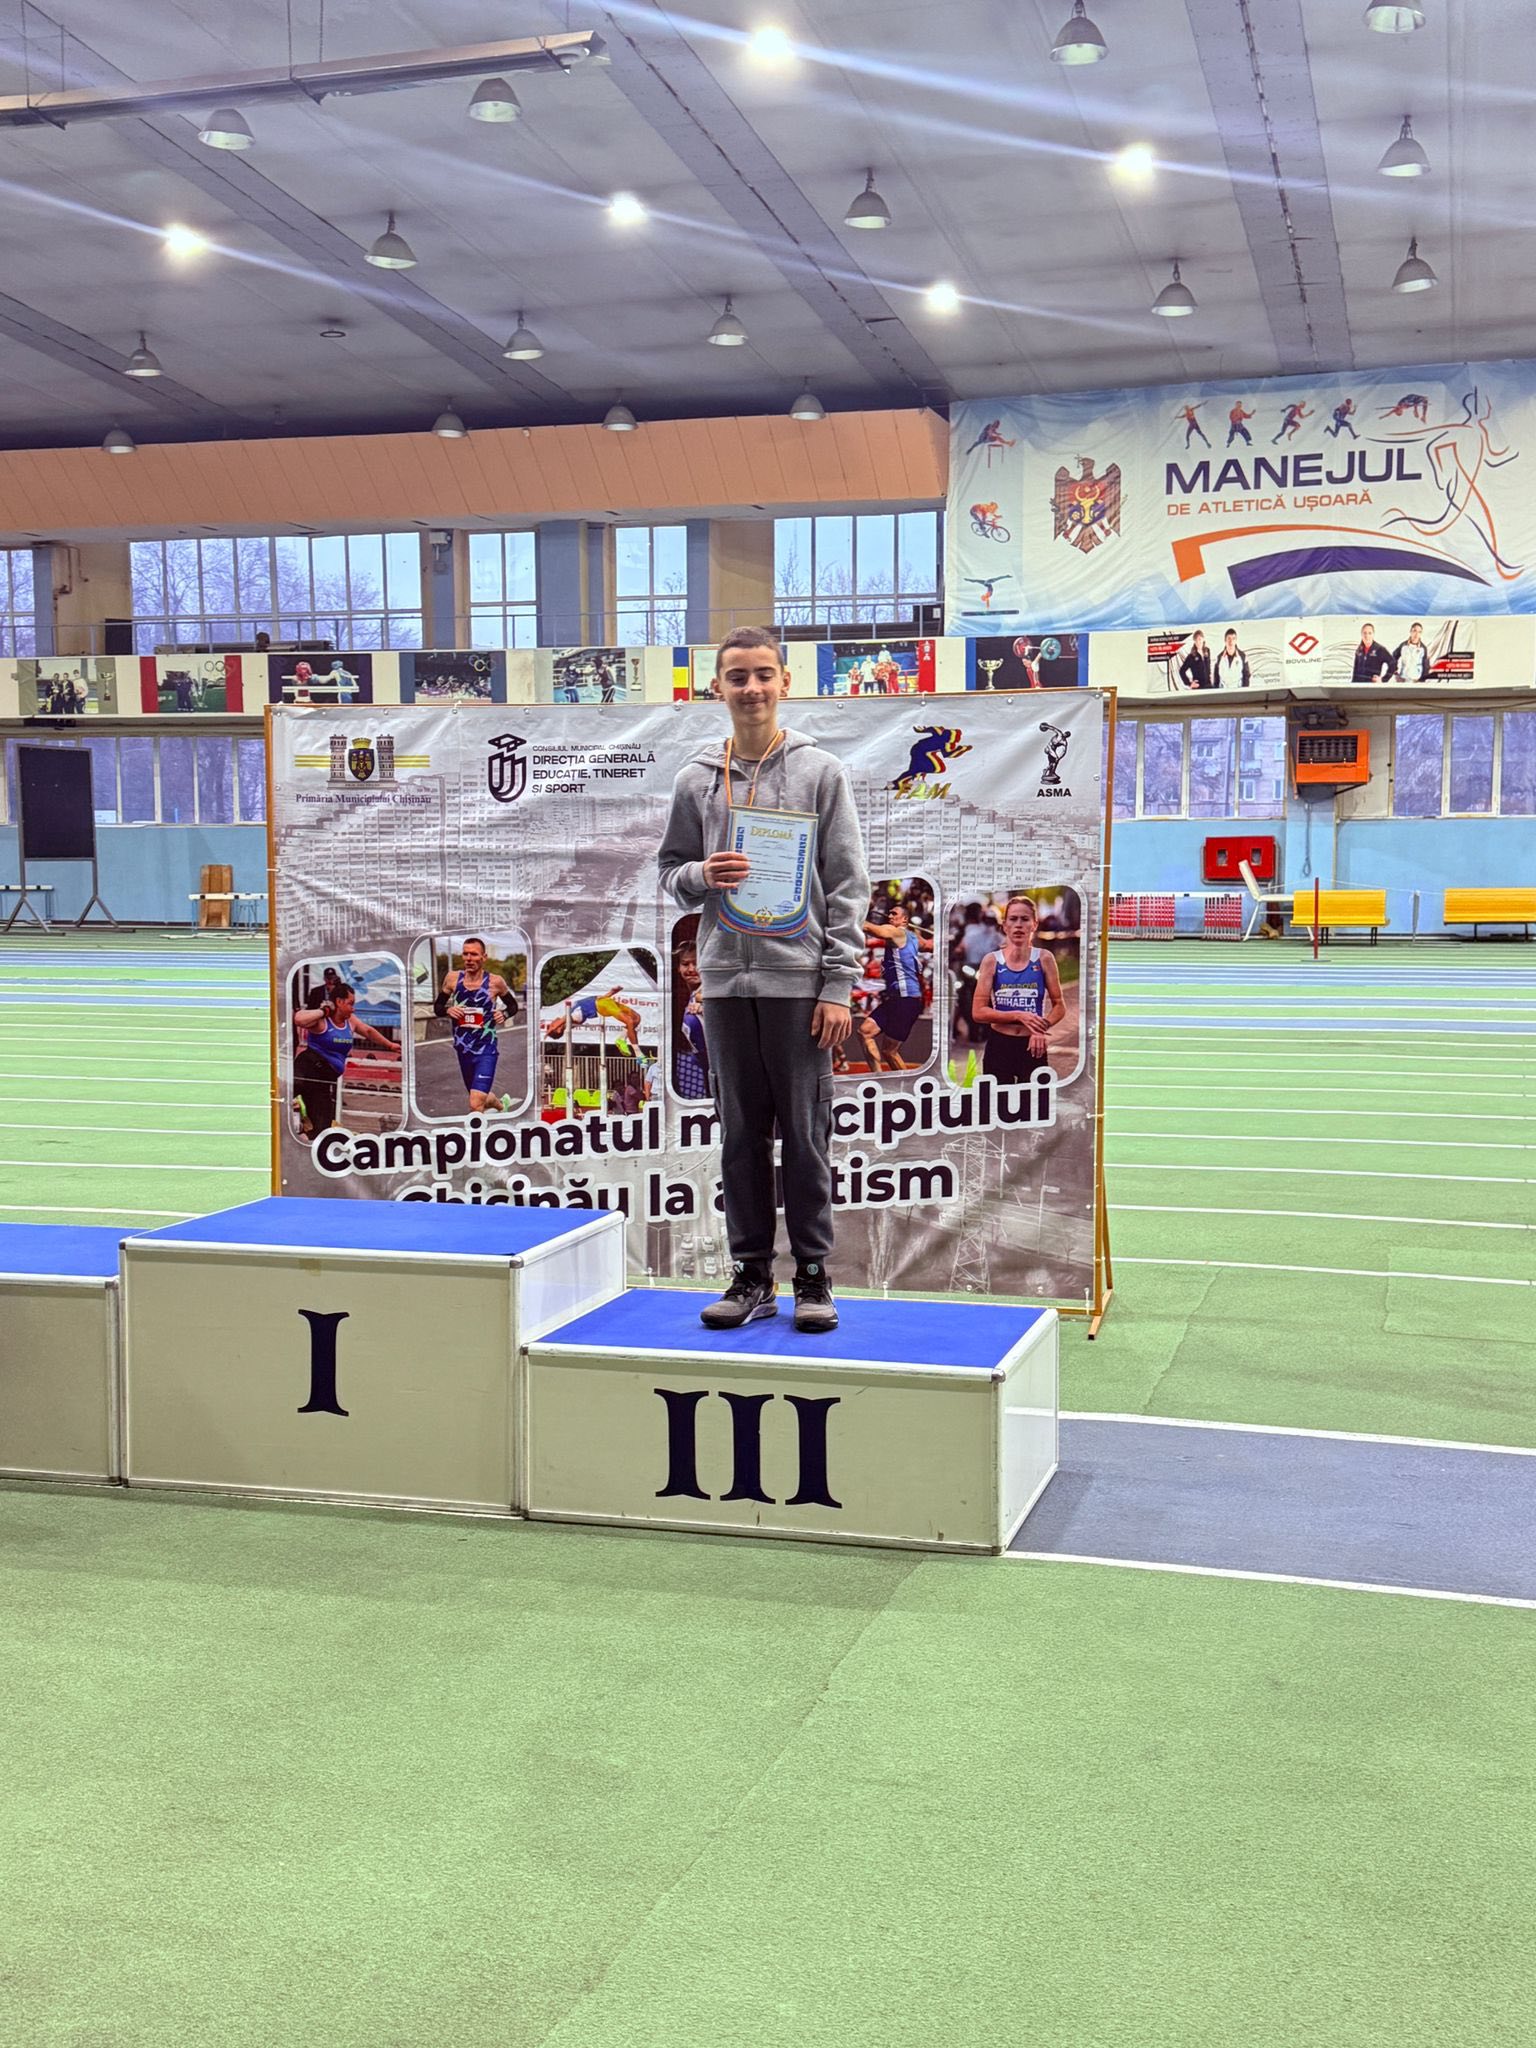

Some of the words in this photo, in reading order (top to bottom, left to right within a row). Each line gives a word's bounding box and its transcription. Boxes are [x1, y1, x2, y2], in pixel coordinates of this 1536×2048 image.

[1166, 448, 1422, 495] MANEJUL
[1167, 503, 1190, 516] DE
[1198, 495, 1286, 514] ATLETICĂ
[1294, 489, 1373, 512] UȘOARĂ
[1285, 656, 1322, 665] BOVILINE
[533, 754, 586, 767] DIRECȚIA
[588, 750, 656, 764] GENERALĂ
[593, 768, 646, 779] TINERET
[544, 783, 586, 794] SPORT
[1036, 788, 1072, 798] ASMA
[296, 793, 333, 804] Primăria
[997, 997, 1037, 1008] MIHAELA
[316, 1107, 660, 1174] Campionatul
[681, 1072, 1051, 1146] mcipiului
[648, 1173, 694, 1216] la
[297, 1308, 350, 1417] I
[653, 1387, 842, 1509] III
